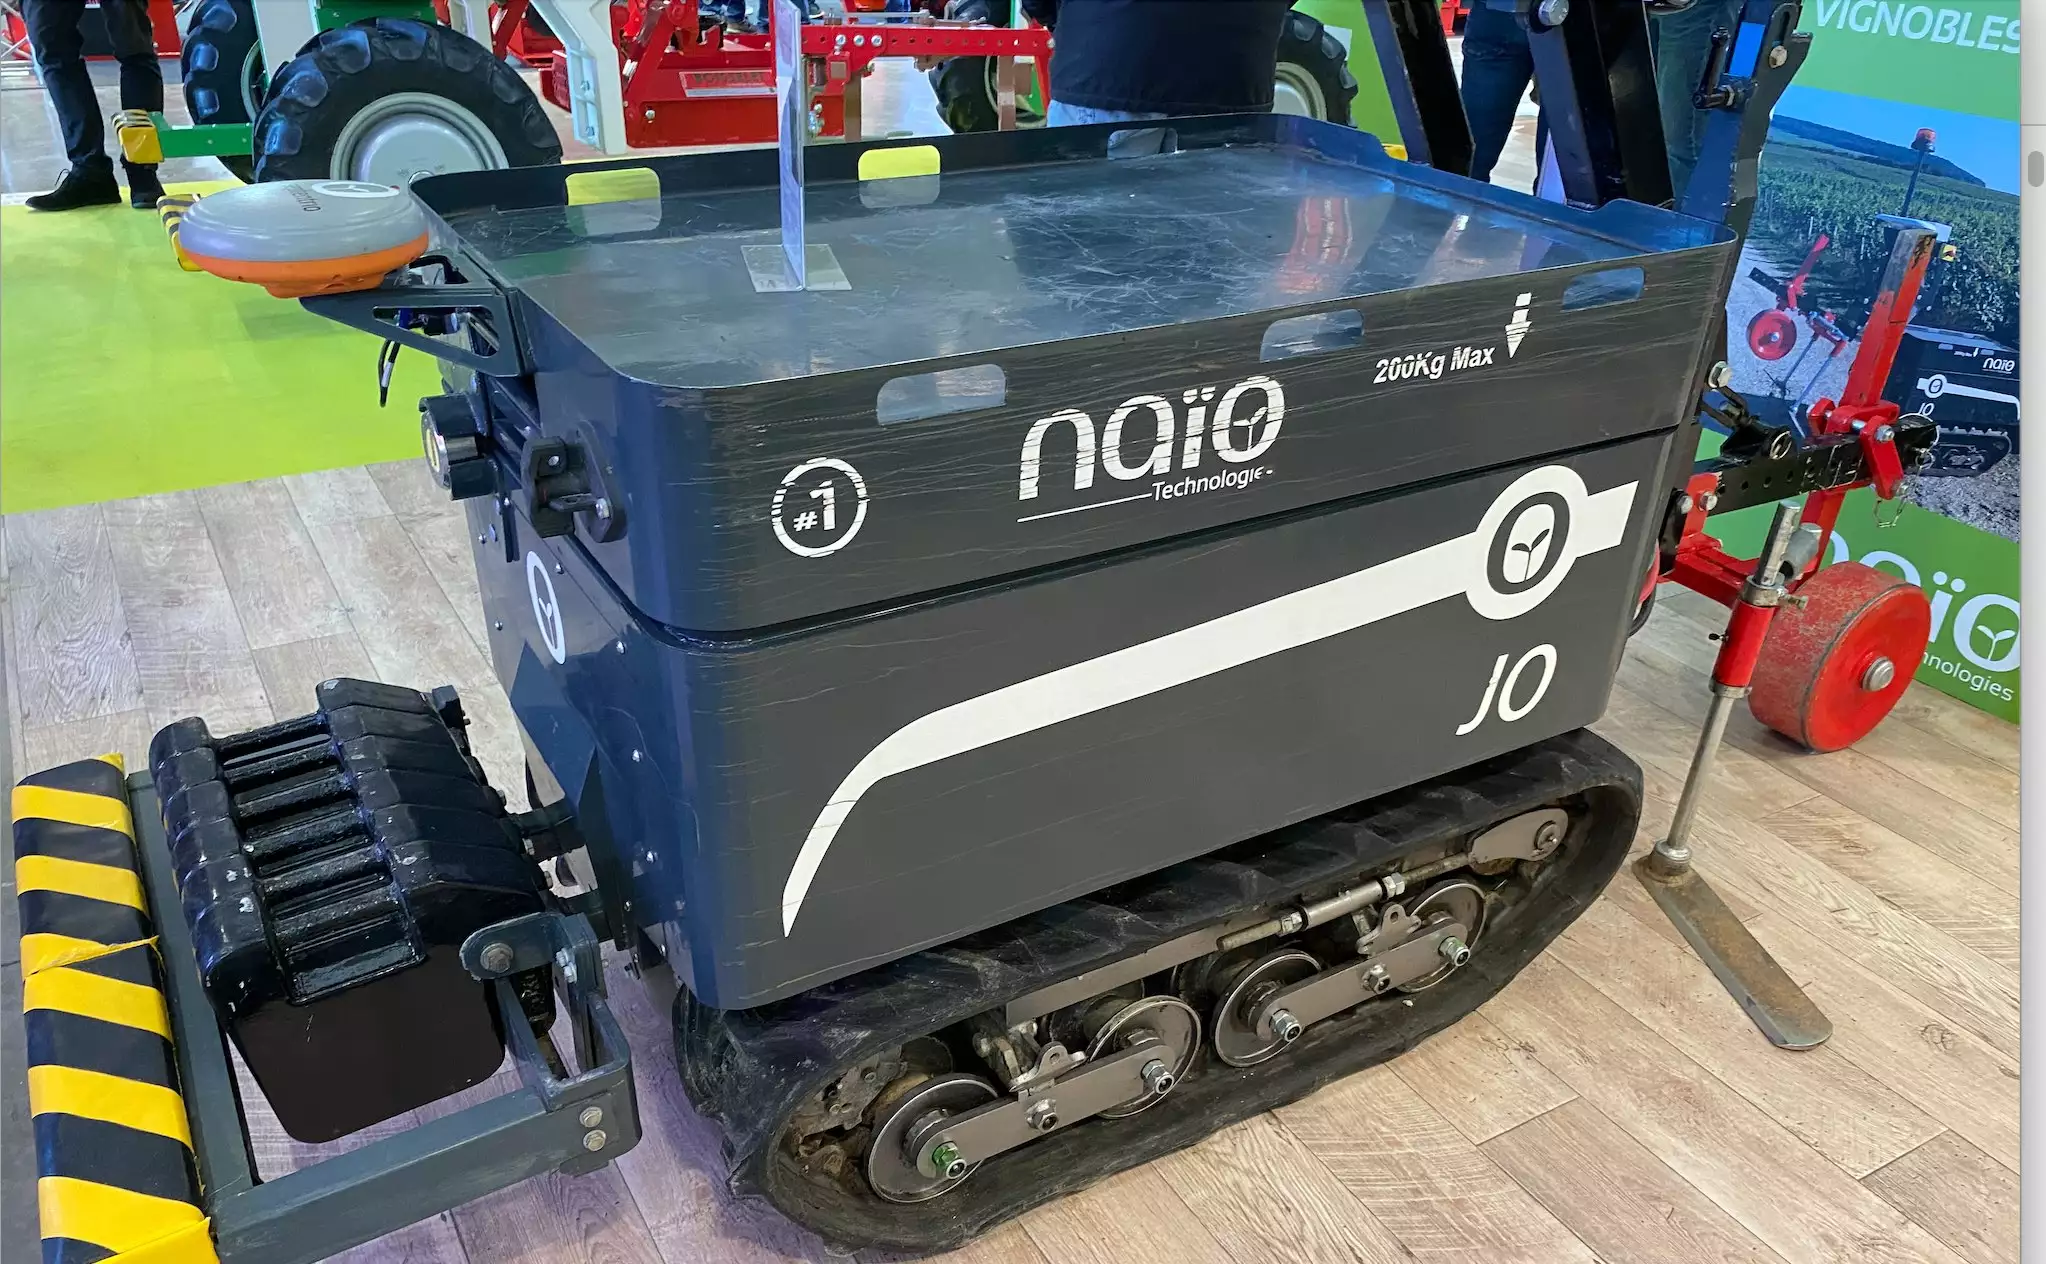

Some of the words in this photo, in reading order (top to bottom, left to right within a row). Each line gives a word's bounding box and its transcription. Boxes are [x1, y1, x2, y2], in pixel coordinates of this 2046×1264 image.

[1816, 0, 2021, 54] VIGNOBLES
[1373, 351, 1446, 384] 200Kg
[1450, 346, 1496, 371] Max
[793, 480, 836, 531] #1
[1151, 466, 1273, 501] Technologie
[1455, 643, 1558, 736] JO
